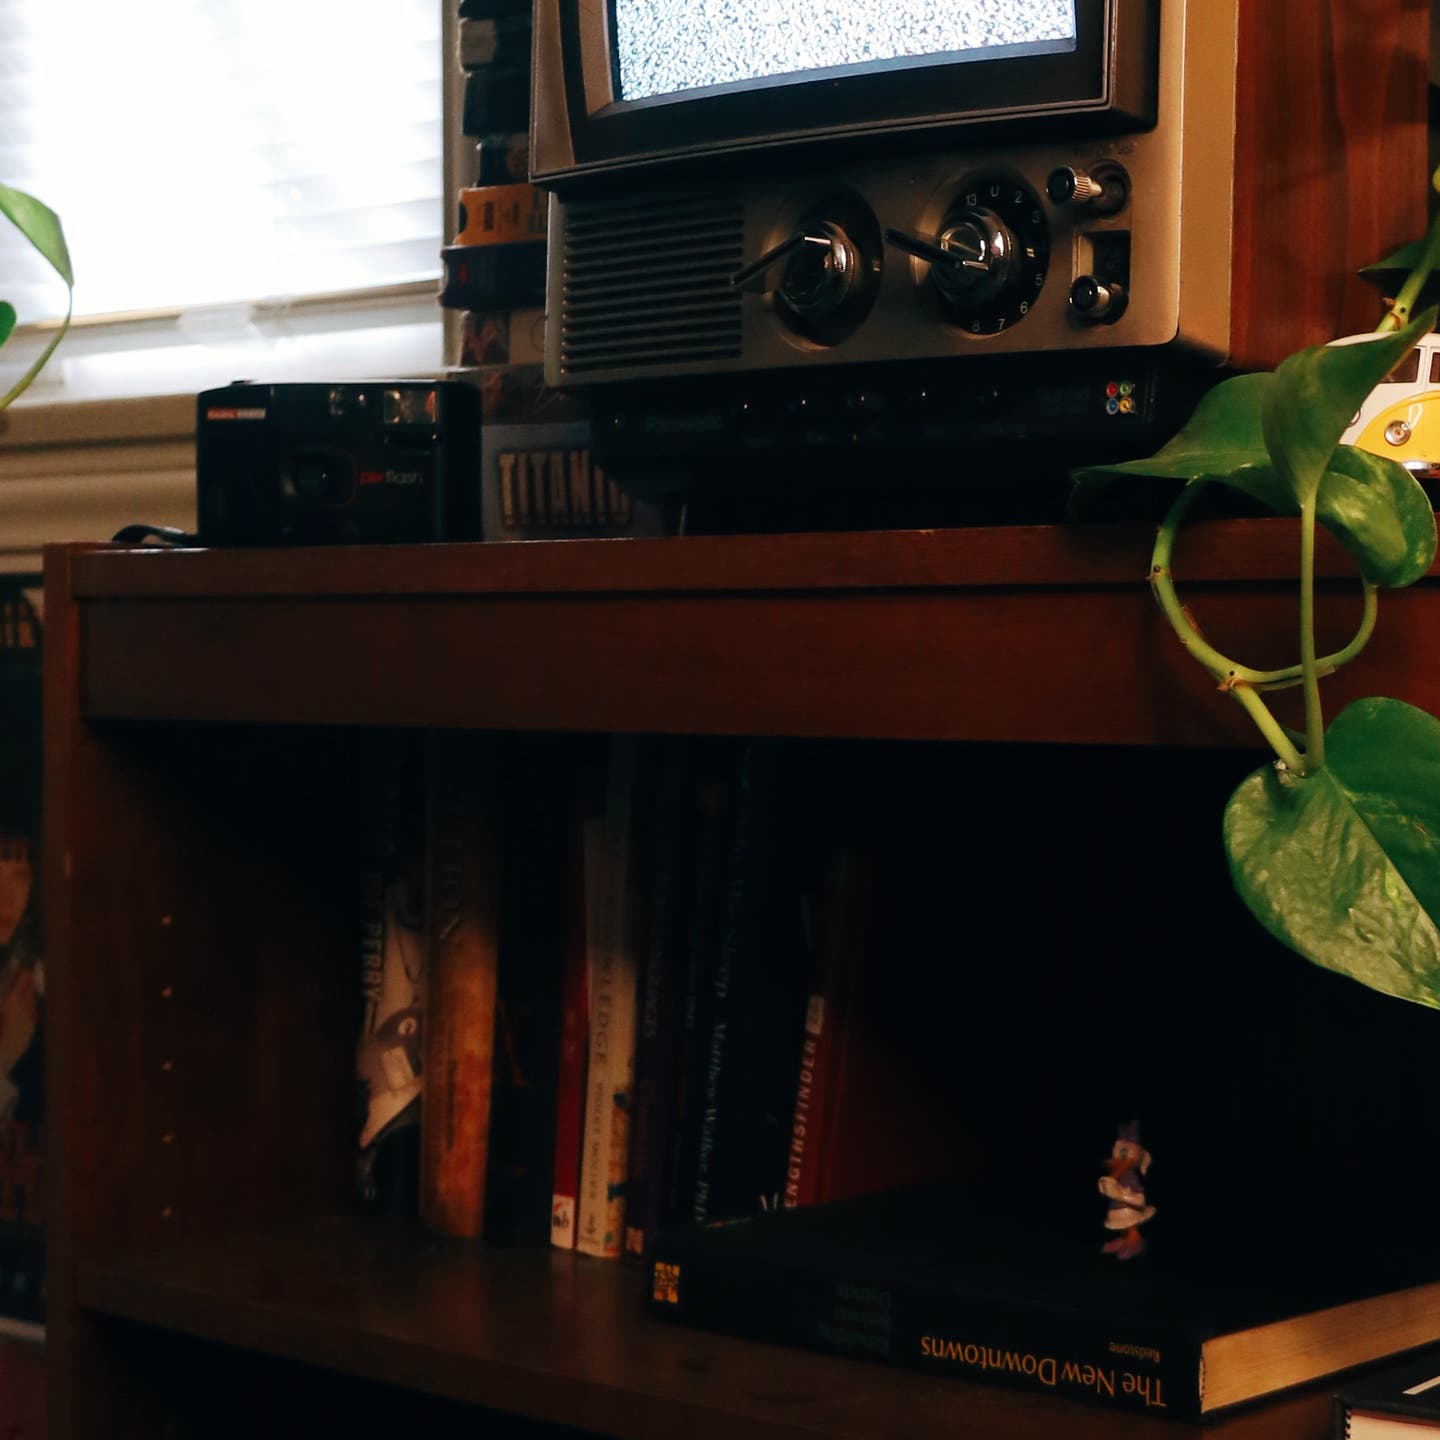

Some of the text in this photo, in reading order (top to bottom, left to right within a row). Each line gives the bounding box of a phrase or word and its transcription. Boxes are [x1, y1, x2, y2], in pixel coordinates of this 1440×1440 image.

[1015, 192, 1024, 204] 2
[1032, 211, 1041, 224] 3
[1035, 273, 1044, 286] 5
[1020, 301, 1028, 315] 6
[998, 318, 1006, 331] 7
[1108, 1339, 1161, 1365] Redstone
[919, 1335, 1166, 1410] The New Downtowns
